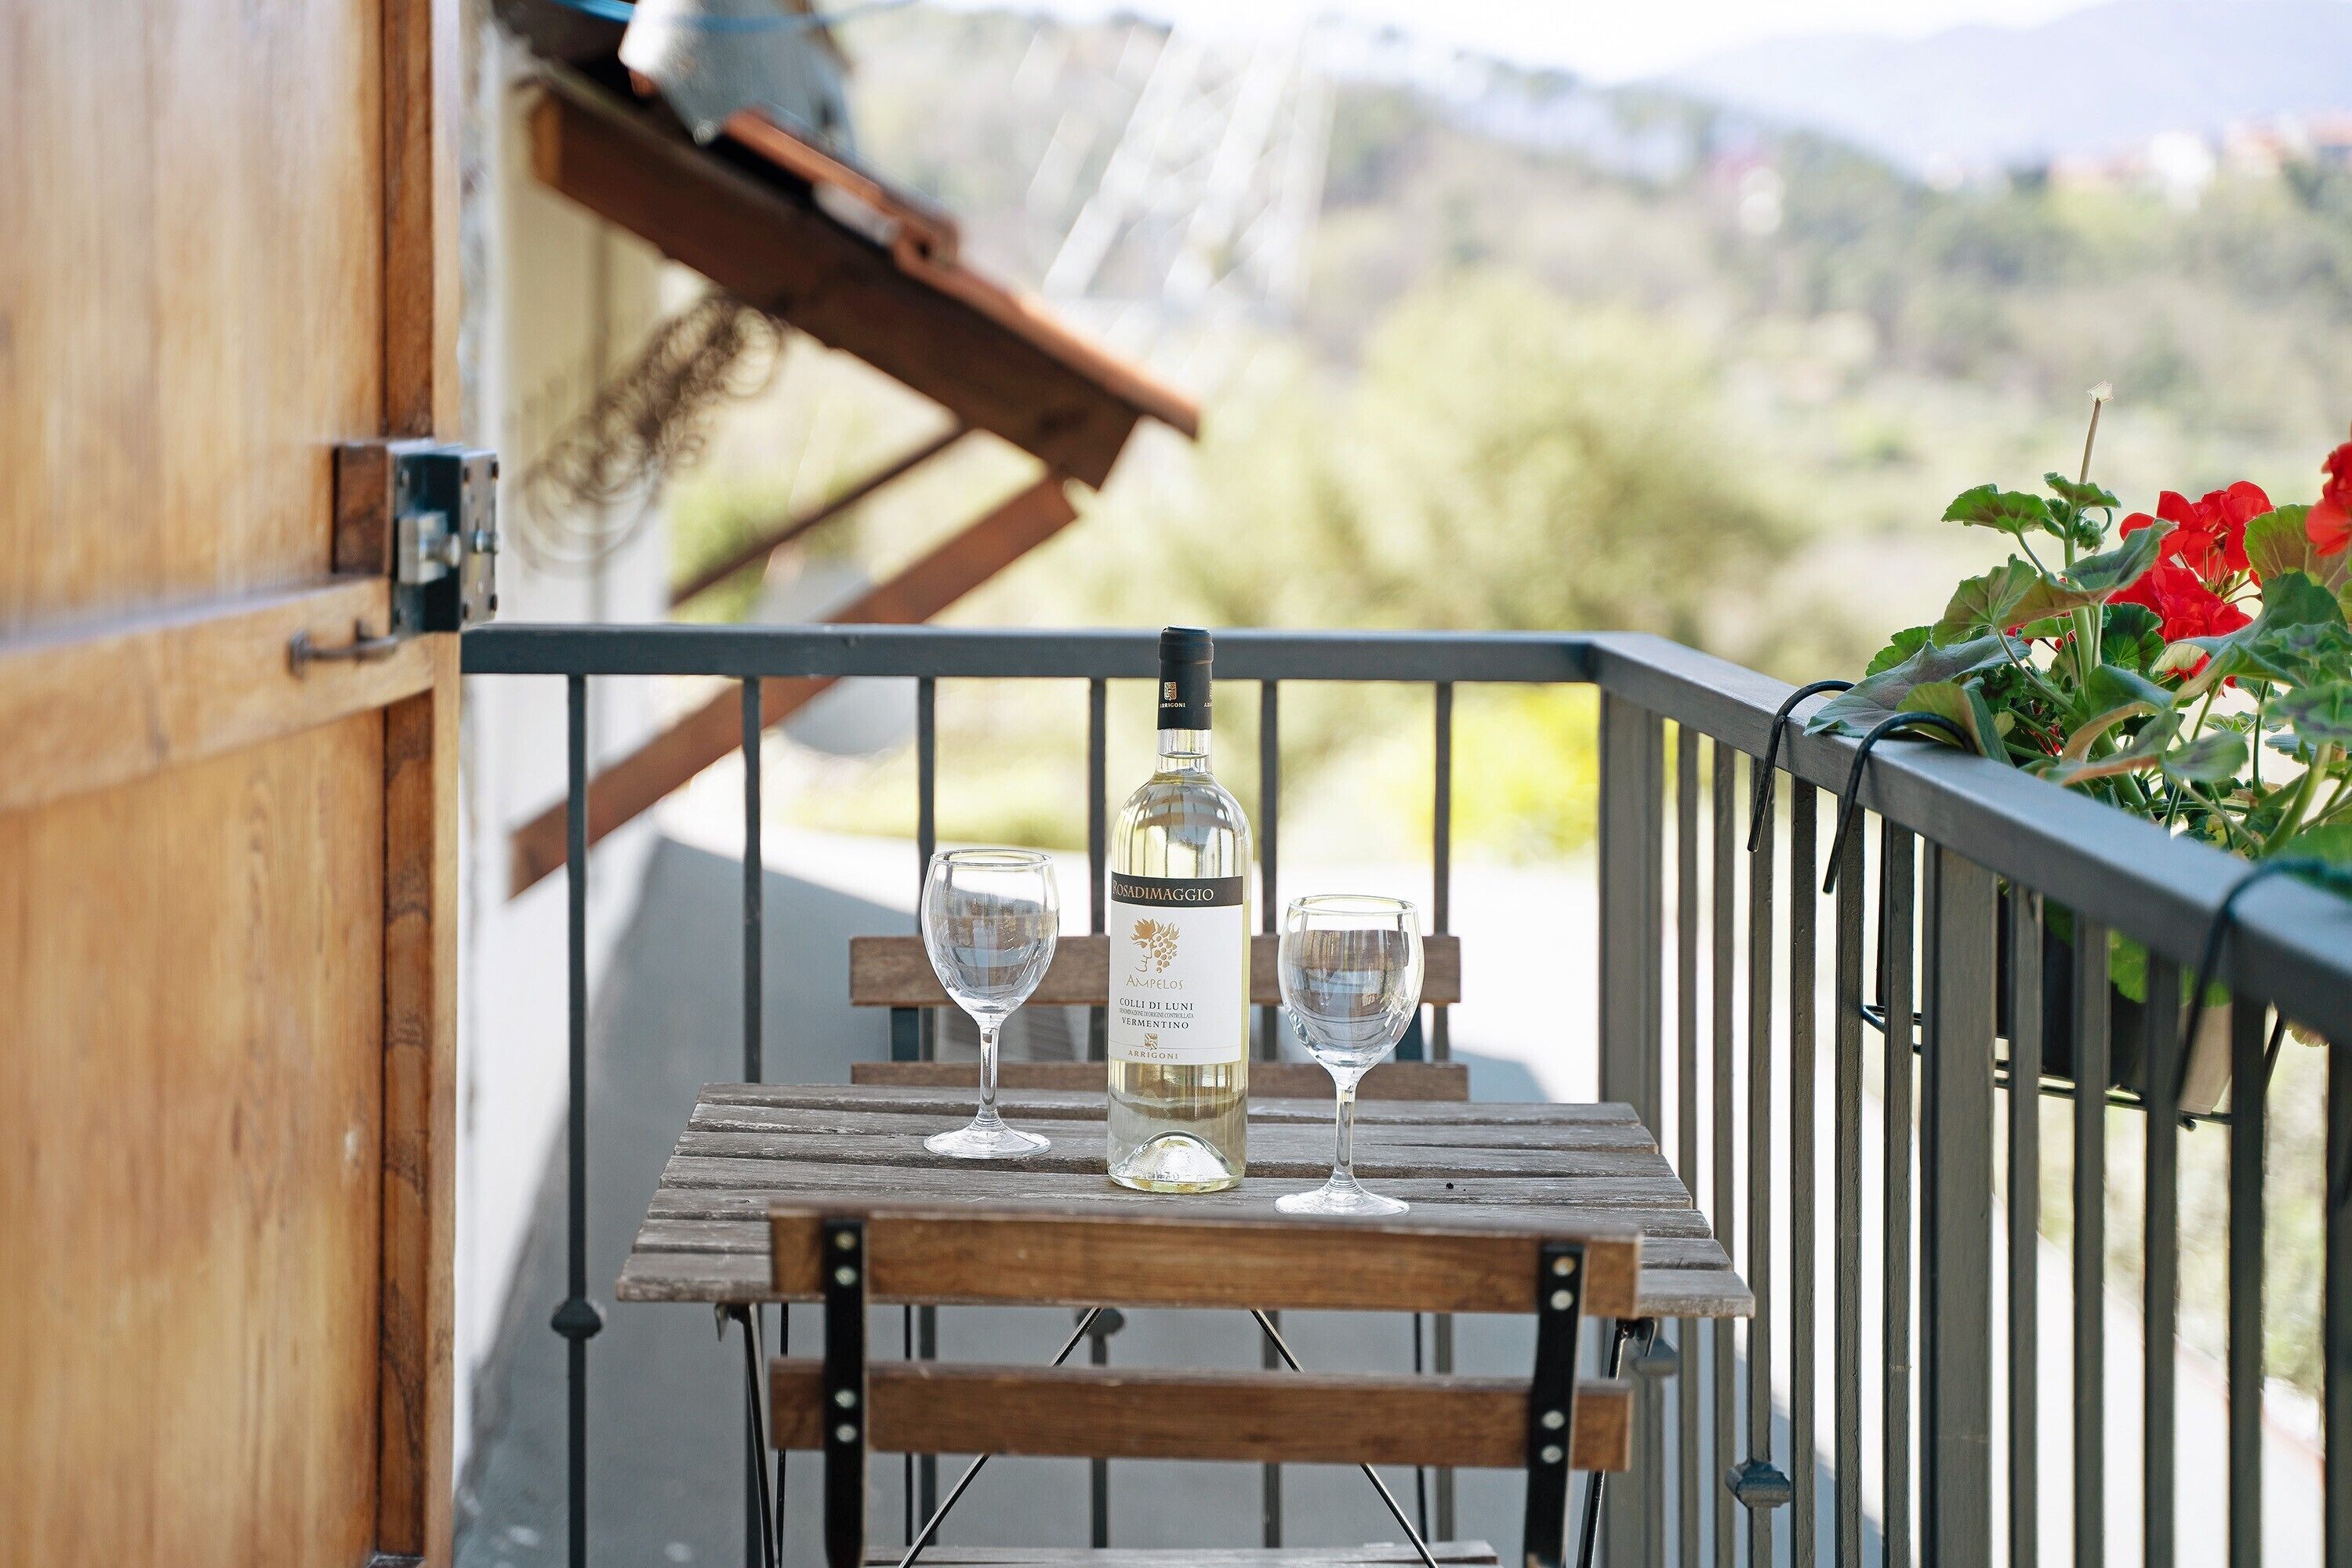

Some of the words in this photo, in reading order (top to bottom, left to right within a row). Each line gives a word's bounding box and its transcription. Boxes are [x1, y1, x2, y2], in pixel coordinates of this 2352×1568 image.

[1112, 880, 1214, 901] ROSADIMAGGIO
[1127, 975, 1183, 989] AMPELOS
[1120, 998, 1145, 1008] COLLI
[1122, 1018, 1189, 1029] VERMENTINO
[1128, 1050, 1178, 1059] ARRIGONI
